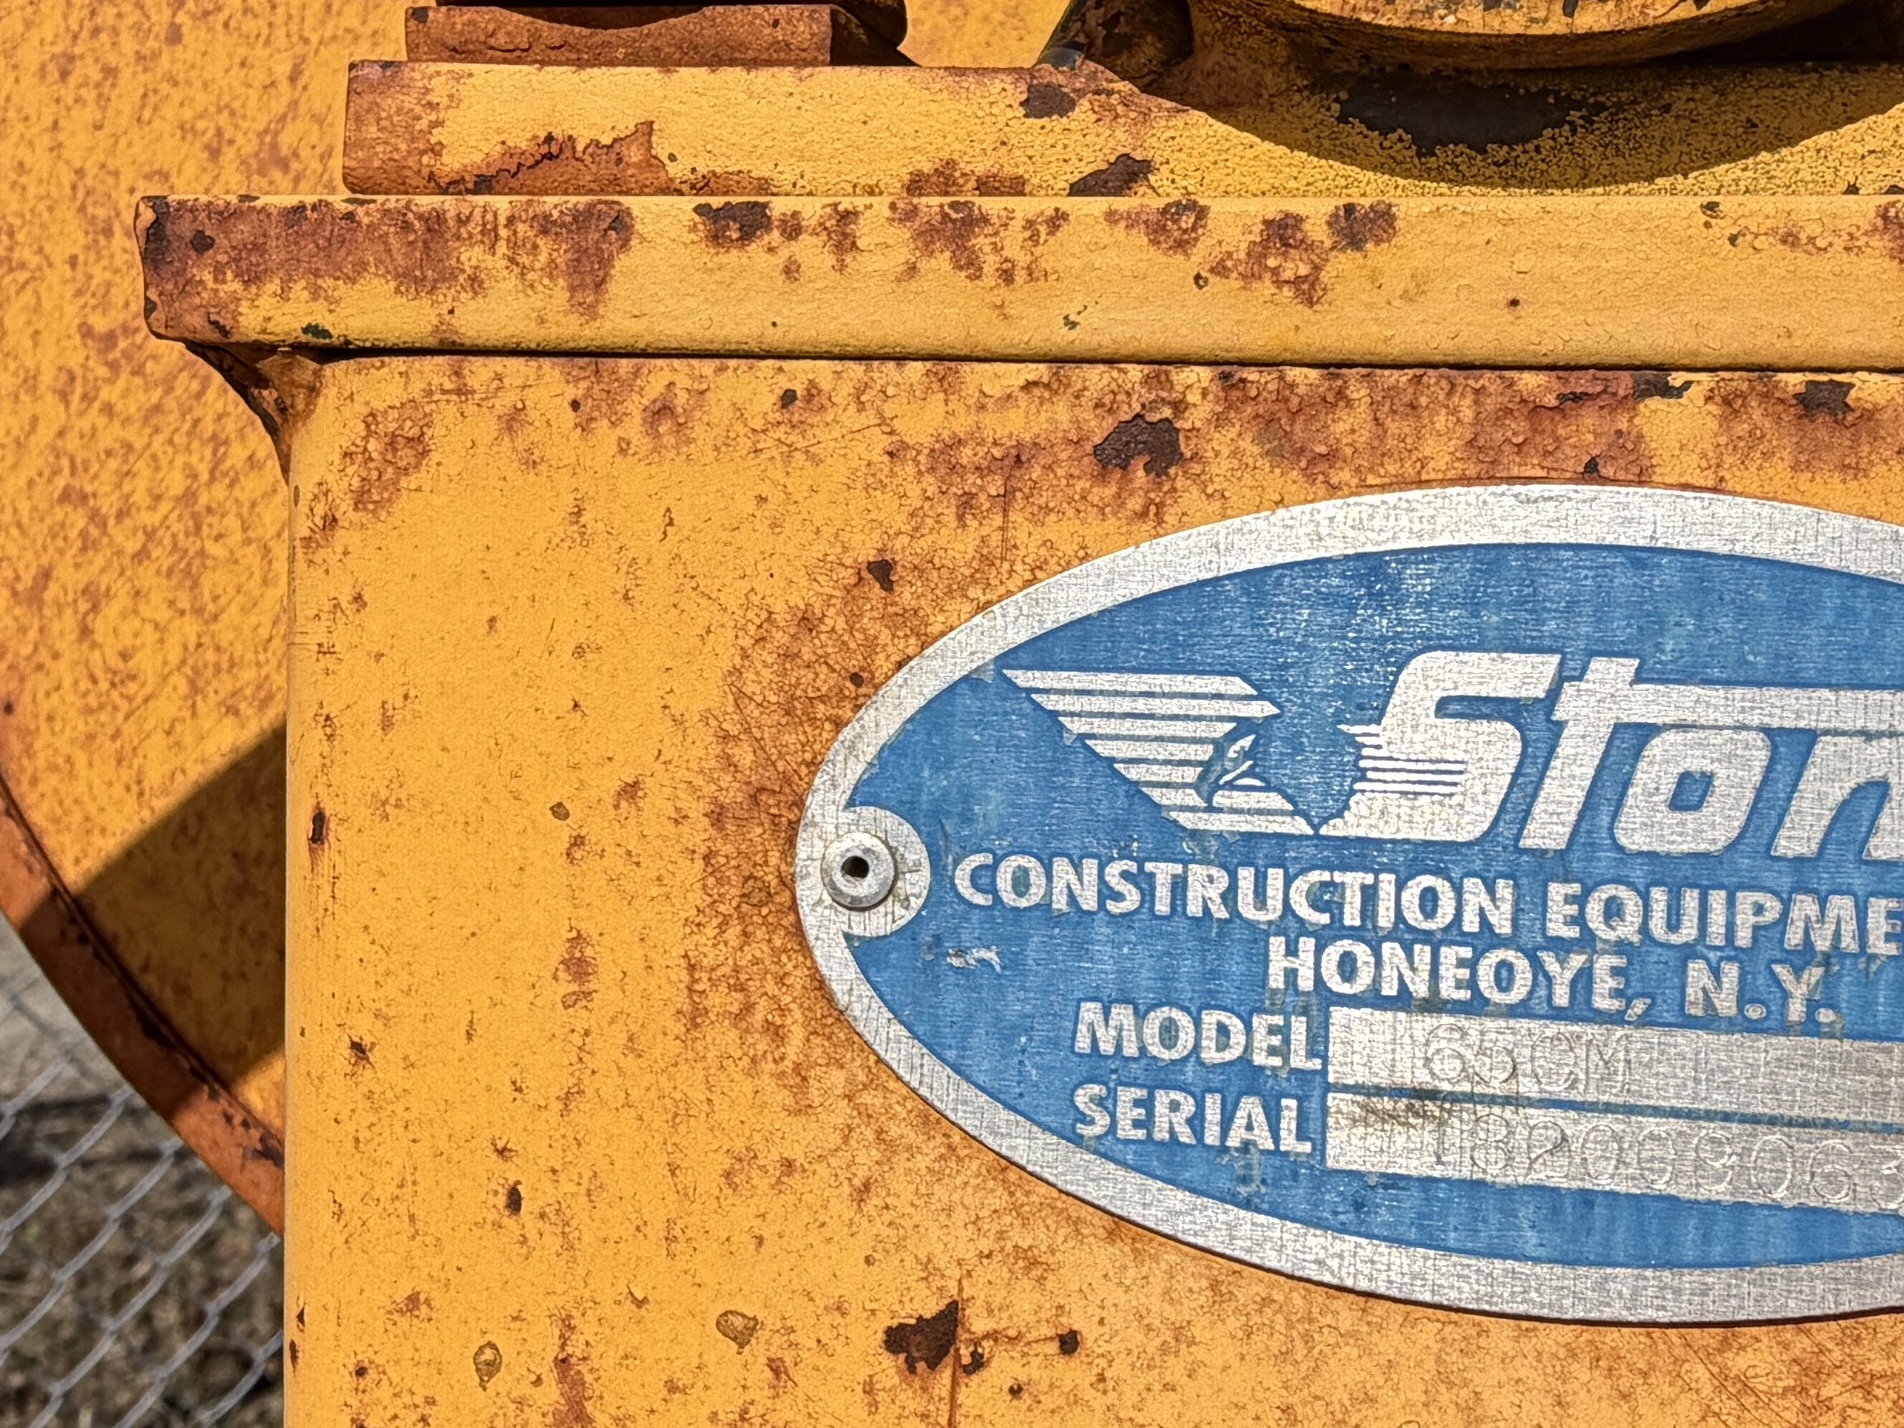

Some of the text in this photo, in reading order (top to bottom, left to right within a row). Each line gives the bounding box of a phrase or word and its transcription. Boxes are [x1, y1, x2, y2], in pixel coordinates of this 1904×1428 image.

[953, 852, 1513, 935] CONSTRUCTION
[1267, 935, 1839, 1024] HONEOYE, N.Y.
[1073, 1001, 1633, 1096] MODEL 65CM
[1072, 1081, 1313, 1153] SERIAL
